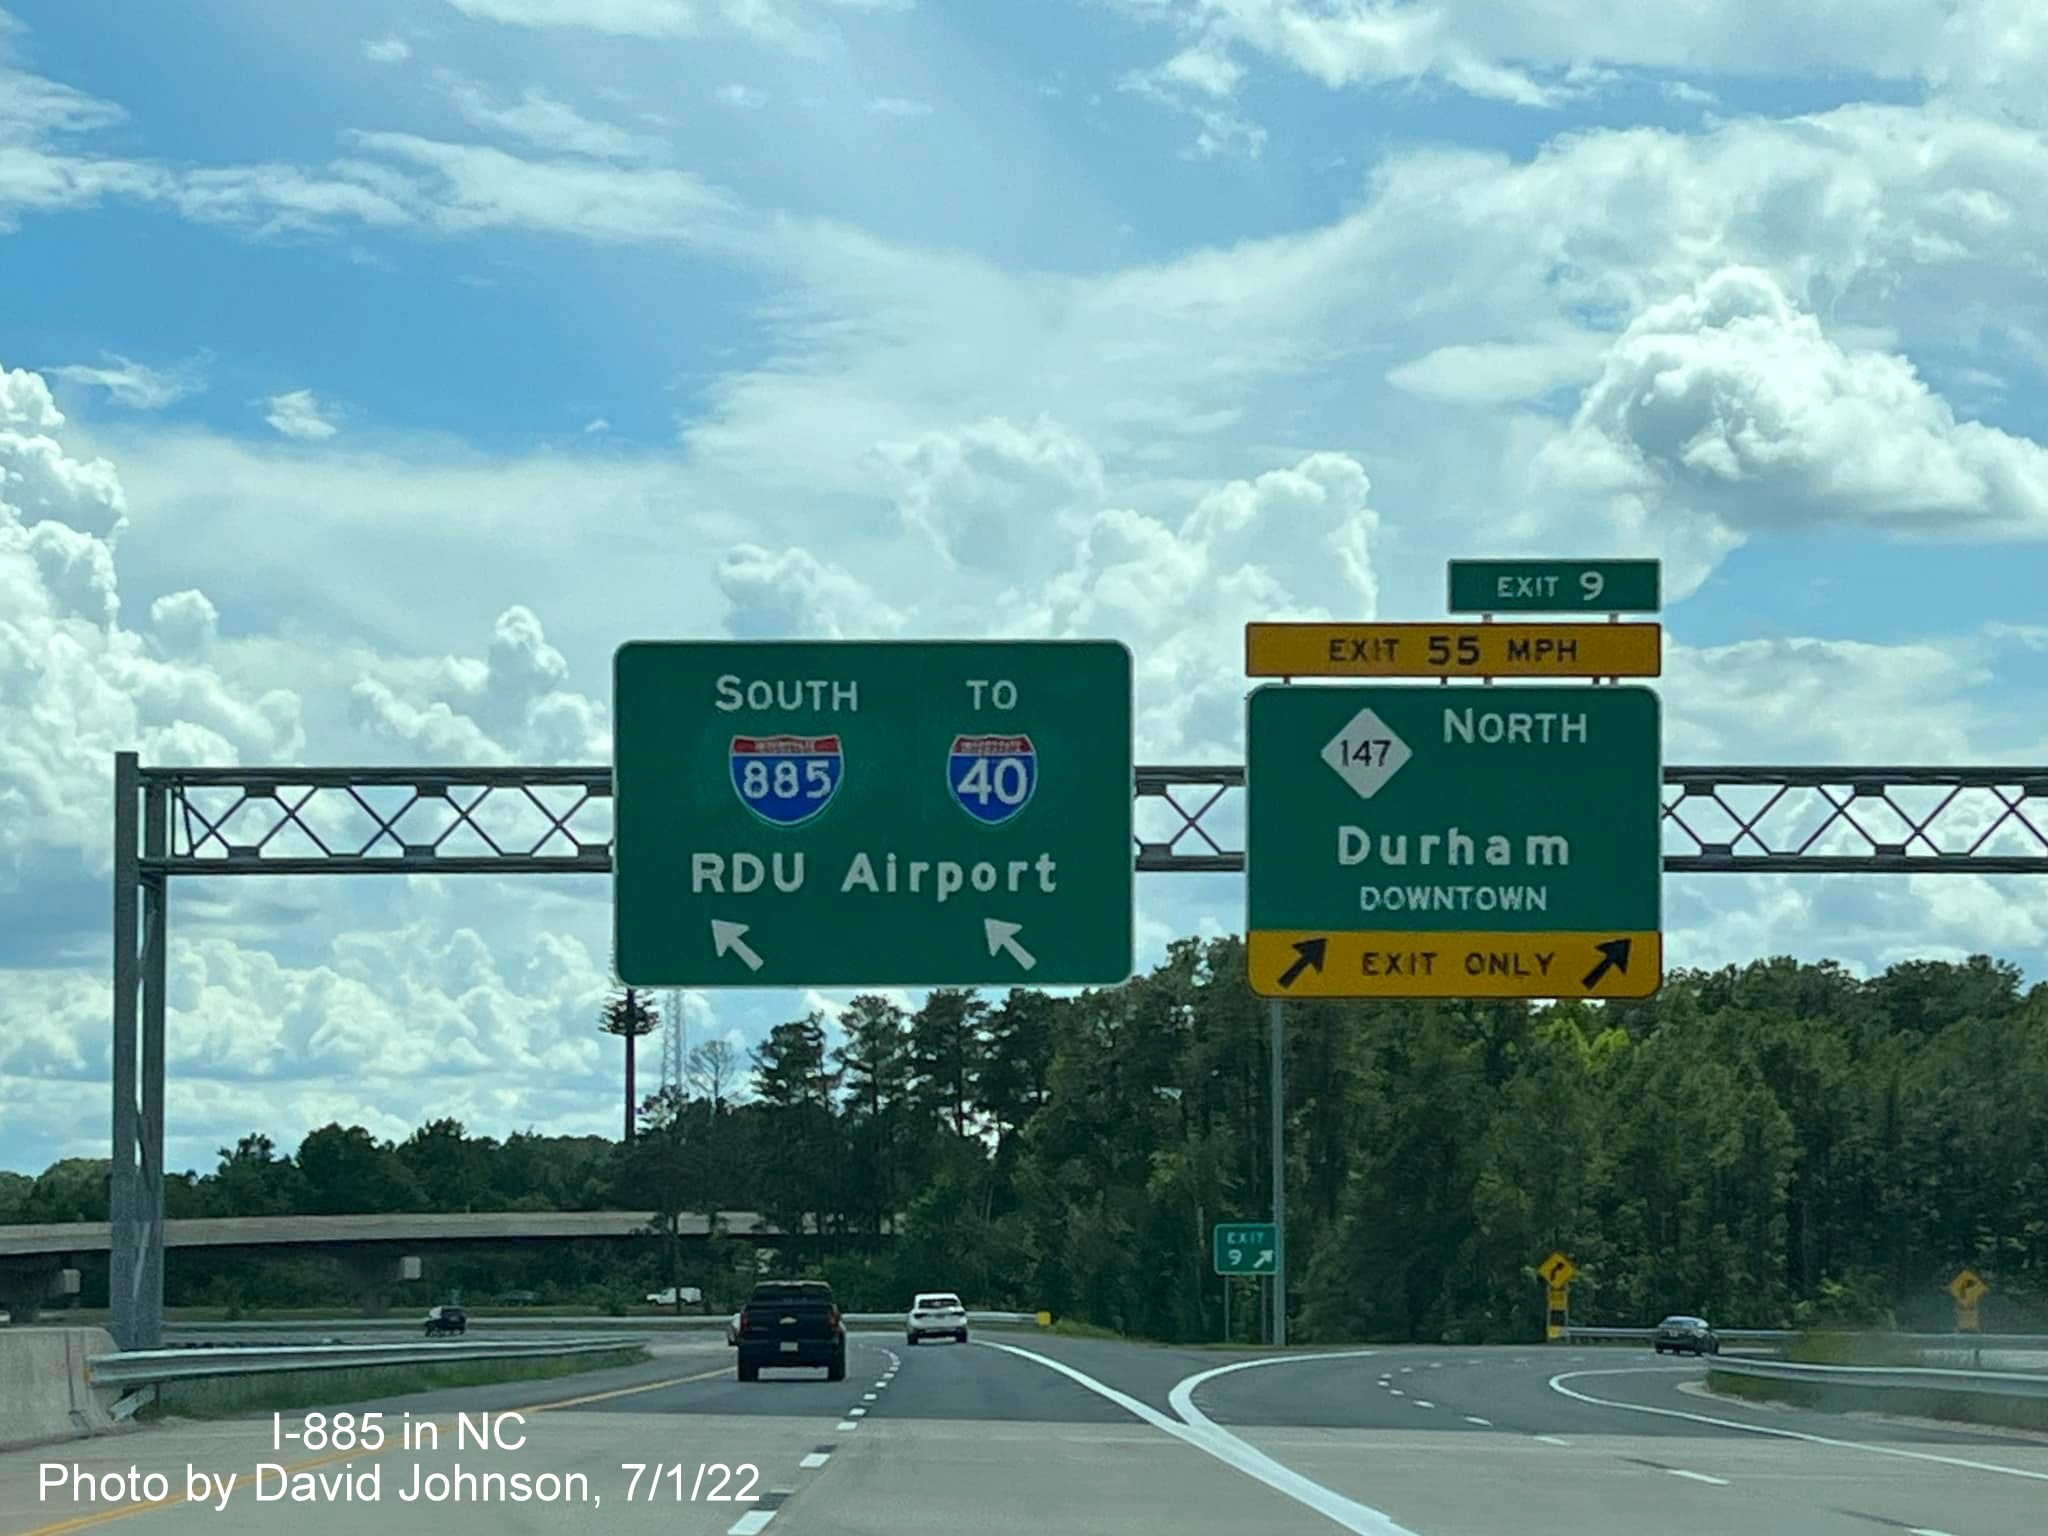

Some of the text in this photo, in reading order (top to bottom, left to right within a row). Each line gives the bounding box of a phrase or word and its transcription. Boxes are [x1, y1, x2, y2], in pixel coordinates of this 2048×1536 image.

[1498, 572, 1604, 600] EXIT 9
[1330, 636, 1577, 665] EXIT 55 MPH
[967, 679, 1017, 710] TO
[1341, 739, 1391, 766] 147
[743, 760, 832, 798] 885
[958, 759, 1027, 805] 40
[1338, 826, 1568, 866] Durham
[693, 852, 1056, 902] RDU Airport
[1361, 886, 1546, 910] DOWNTOWN
[1363, 952, 1556, 976] EXIT ONLY
[1227, 1232, 1264, 1244] EXIT
[1228, 1249, 1242, 1265] 9
